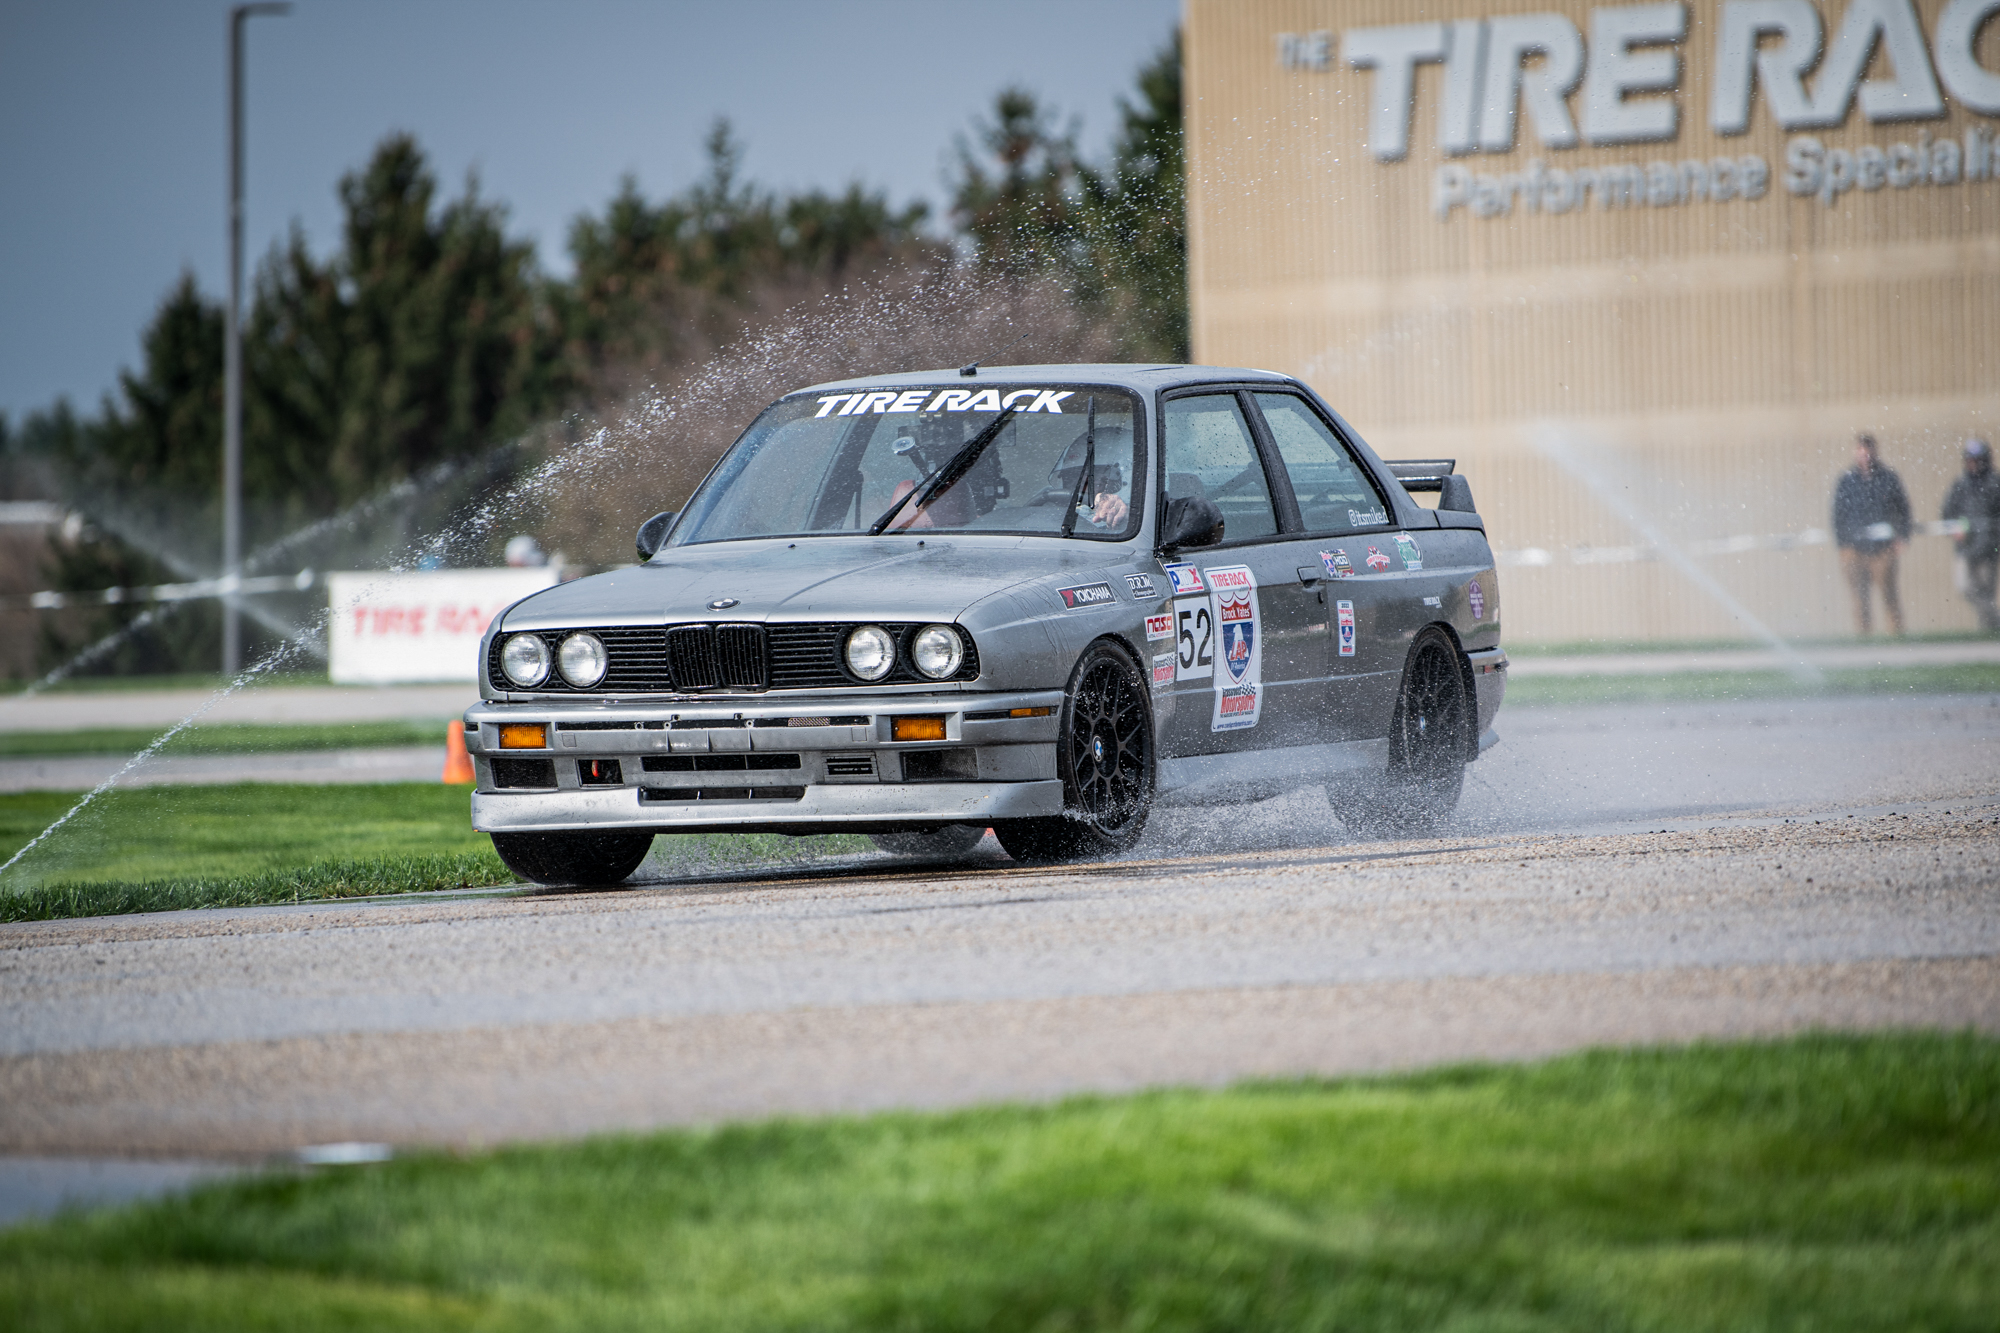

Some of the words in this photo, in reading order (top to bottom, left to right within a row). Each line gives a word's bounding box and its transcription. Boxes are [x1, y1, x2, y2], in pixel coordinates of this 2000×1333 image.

[1342, 2, 1689, 164] TIRE
[1433, 156, 1770, 222] Performance
[814, 390, 933, 419] TIRE
[925, 389, 1076, 414] RACK
[1211, 573, 1230, 588] TIRE
[1228, 571, 1252, 591] RACK
[1073, 586, 1113, 603] YOKOHAMA
[353, 606, 427, 636] TIRE
[436, 603, 505, 634] RA
[1147, 616, 1173, 634] nasa
[1222, 608, 1236, 620] Brock
[1179, 608, 1212, 669] 52
[1230, 640, 1247, 661] LAP
[1220, 694, 1256, 716] Motorsports
